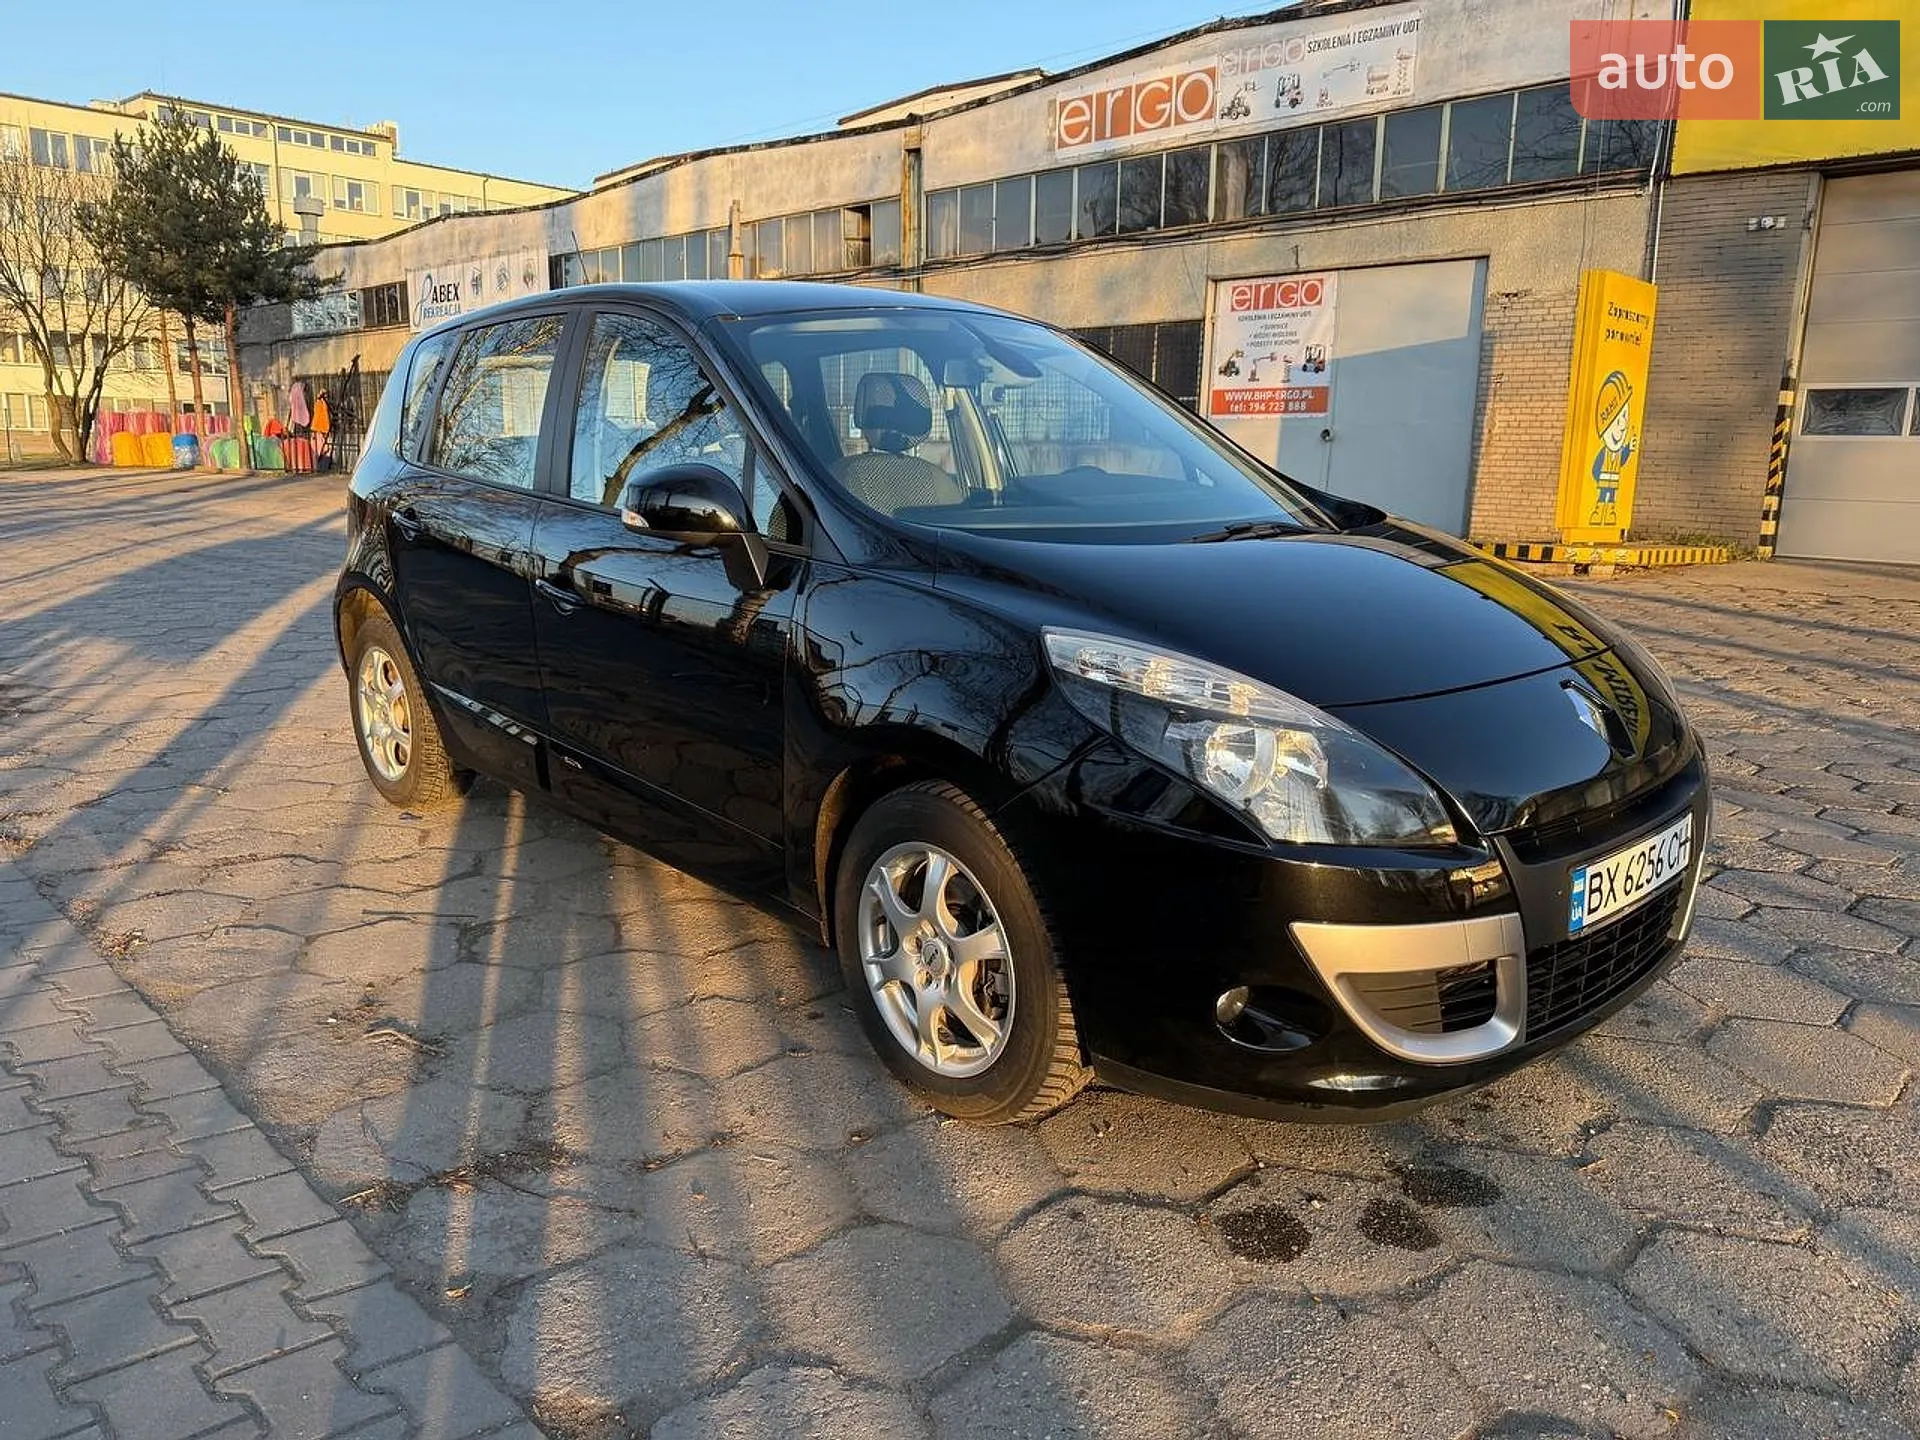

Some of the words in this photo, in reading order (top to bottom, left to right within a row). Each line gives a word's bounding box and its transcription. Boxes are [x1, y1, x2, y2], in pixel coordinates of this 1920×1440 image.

[1306, 34, 1351, 54] SZKOLENIA
[1357, 23, 1402, 44] EGZAMINY
[1402, 18, 1421, 34] UDT
[1224, 389, 1314, 401] WWW.BHP-ERGO.PL
[1267, 402, 1285, 411] 723
[1587, 861, 1620, 916] BX
[1623, 839, 1665, 897] 6256
[1667, 823, 1691, 870] CH
